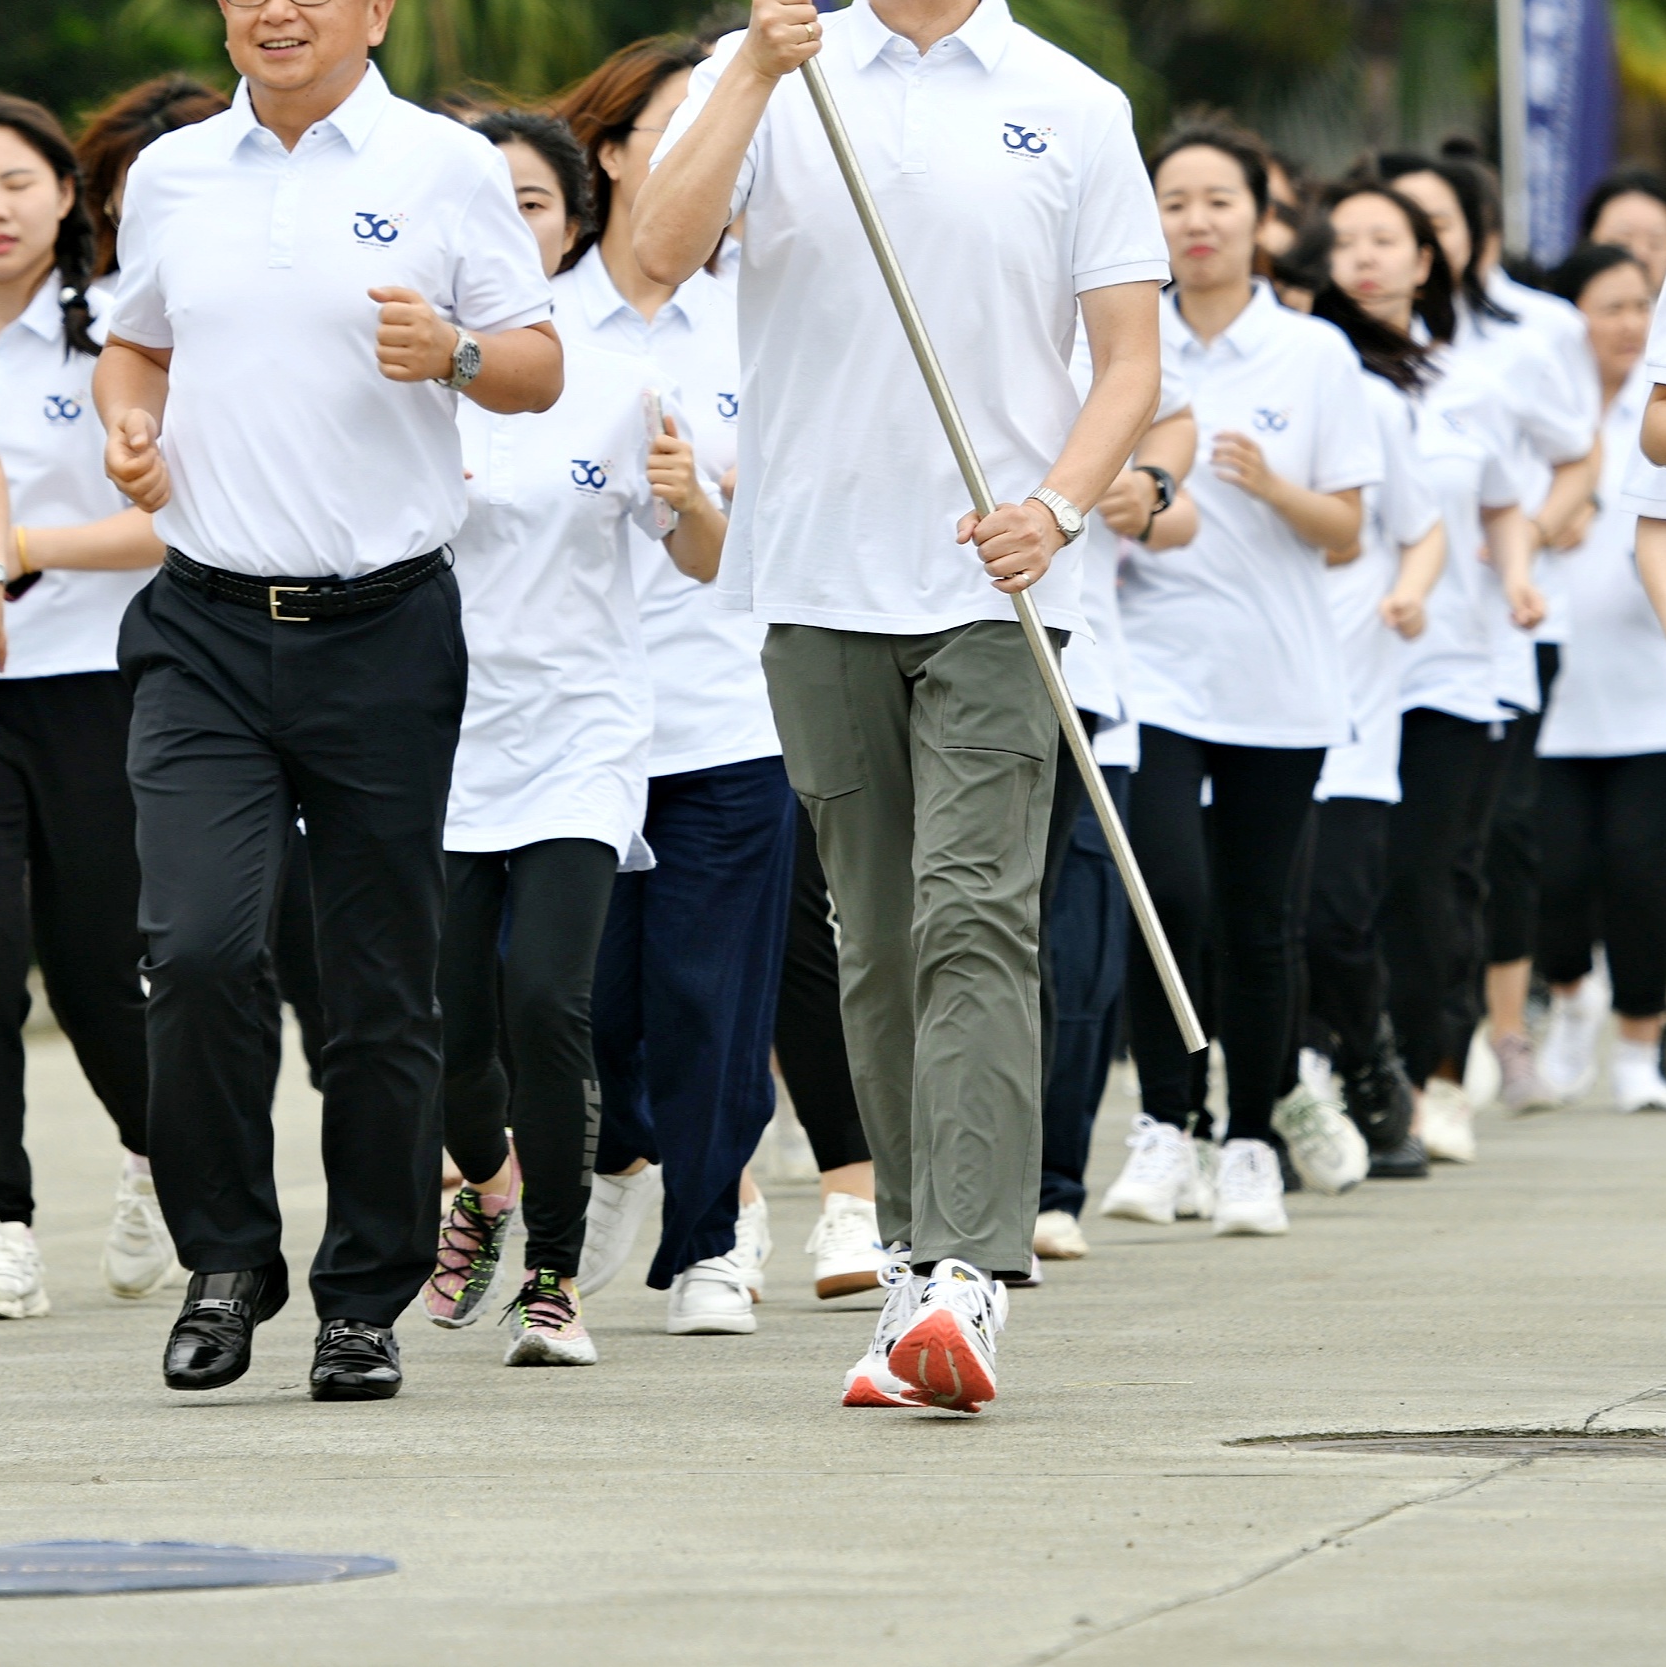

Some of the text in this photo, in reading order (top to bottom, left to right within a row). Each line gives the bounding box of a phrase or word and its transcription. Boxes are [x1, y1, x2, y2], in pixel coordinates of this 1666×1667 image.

[1002, 122, 1048, 154] 30
[353, 212, 399, 242] 30
[44, 395, 83, 420] 30
[718, 392, 740, 419] 3
[571, 459, 609, 490] 30
